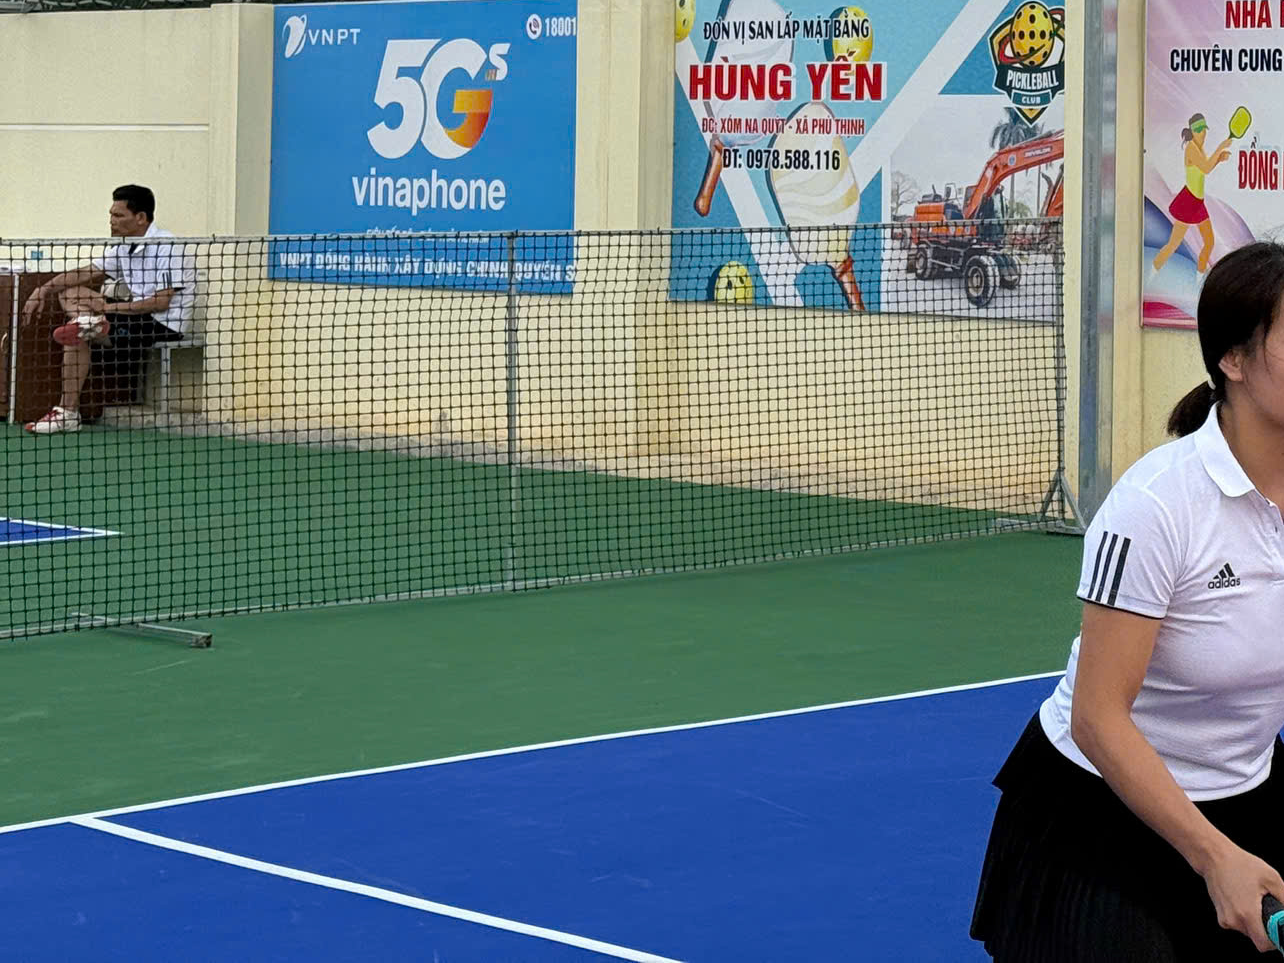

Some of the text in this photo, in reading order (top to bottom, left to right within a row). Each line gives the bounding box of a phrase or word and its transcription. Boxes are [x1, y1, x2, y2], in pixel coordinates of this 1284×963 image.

[308, 28, 361, 46] VNPT
[545, 16, 577, 37] 18001
[733, 21, 746, 45] VỊ
[749, 20, 774, 40] SAN
[777, 11, 799, 39] LẤP
[803, 15, 830, 43] MẶT
[1169, 44, 1233, 72] CHUYÊN
[1238, 48, 1283, 72] CUNG
[689, 48, 883, 101] HÙNG YẾN
[1006, 69, 1060, 90] PICKLEBALL
[1021, 96, 1041, 104] CLUB
[745, 118, 759, 134] NA
[835, 118, 865, 138] THỊNH
[722, 149, 841, 170] ĐT: 0978.588.116
[1238, 136, 1278, 190] ĐỒNG
[352, 168, 506, 216] vinaphone
[279, 252, 313, 269] VNPT
[1207, 577, 1241, 589] adidas
